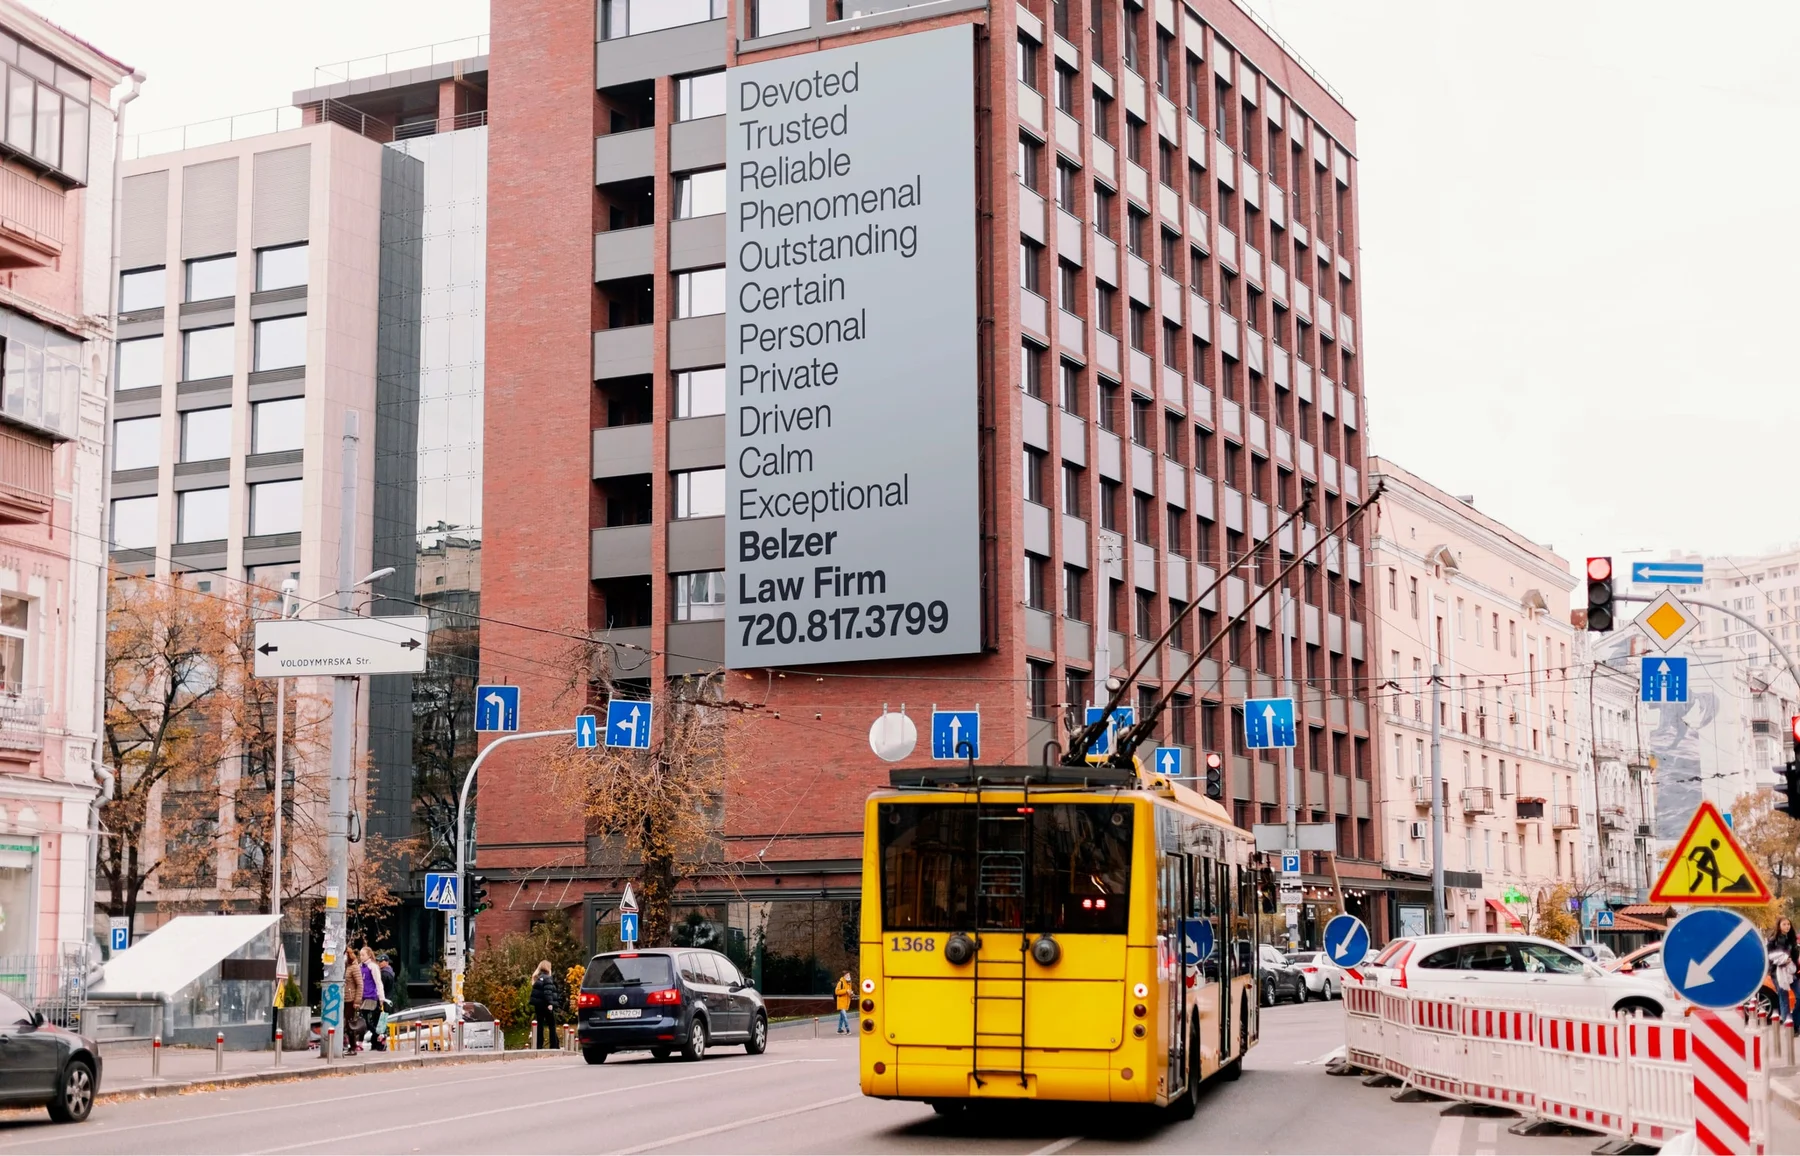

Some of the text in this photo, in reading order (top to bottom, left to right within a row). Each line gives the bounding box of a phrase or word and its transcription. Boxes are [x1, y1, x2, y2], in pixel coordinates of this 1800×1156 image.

[740, 62, 859, 111] Devoted
[739, 105, 848, 150] Trusted
[740, 148, 851, 191] Reliable
[740, 175, 921, 232] Phenomenal
[739, 224, 917, 272] Outstanding
[739, 274, 845, 313] Certain
[740, 308, 866, 354] Personal
[739, 358, 839, 395] Private
[739, 404, 831, 437] Driven
[739, 444, 813, 478] Calm
[739, 473, 909, 522] Exceptional
[739, 528, 838, 562] Belzer
[739, 566, 886, 604] Law Firm
[738, 600, 949, 646] 720.817.3799
[281, 657, 371, 667] VOLODYMYRSKA Str.
[891, 936, 935, 952] 1368
